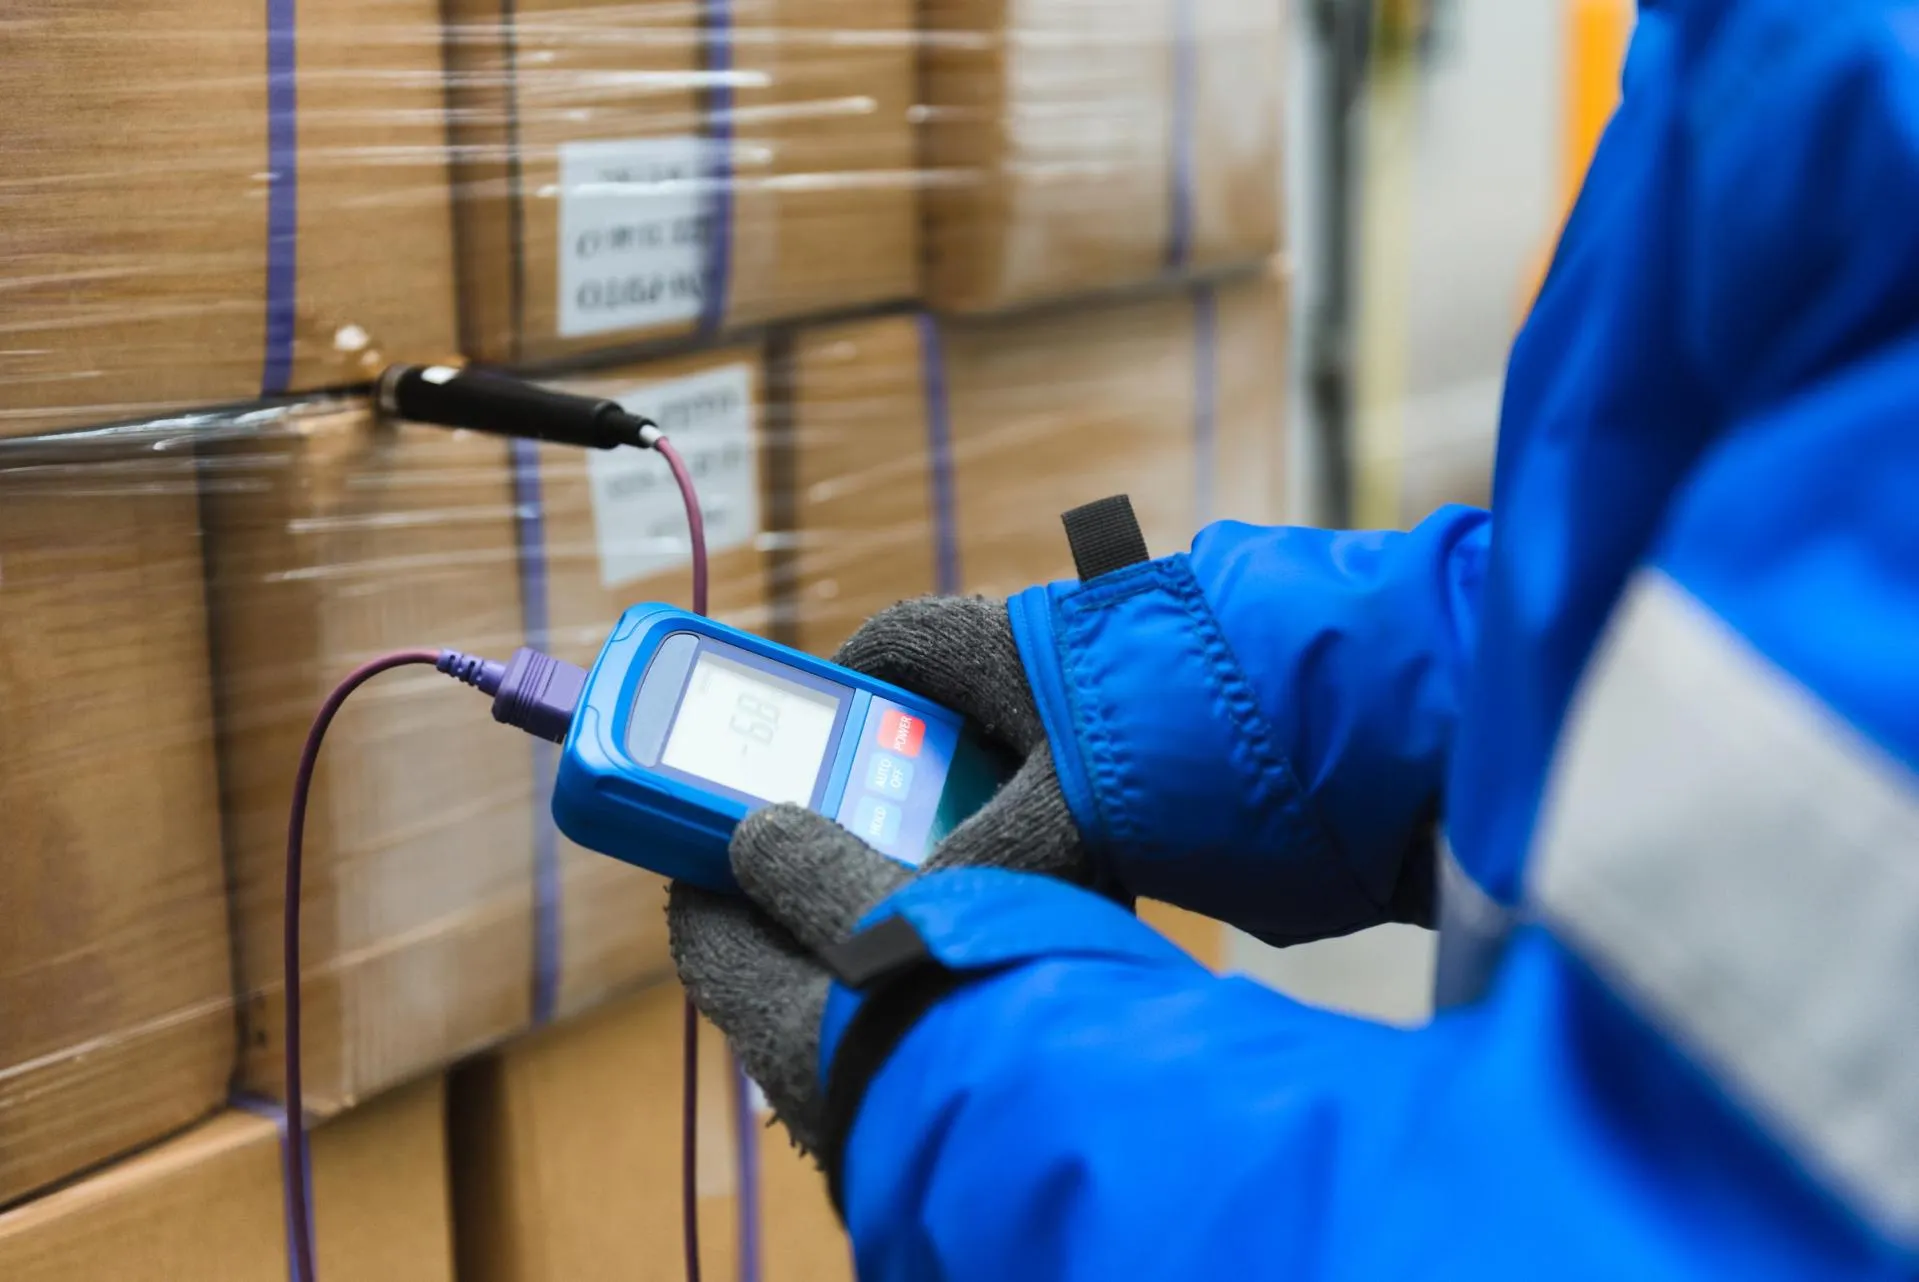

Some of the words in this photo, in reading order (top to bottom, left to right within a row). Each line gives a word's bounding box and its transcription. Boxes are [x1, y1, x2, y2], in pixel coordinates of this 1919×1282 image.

[894, 715, 912, 752] POWER
[875, 758, 892, 789] AUTO
[890, 767, 905, 789] OFF
